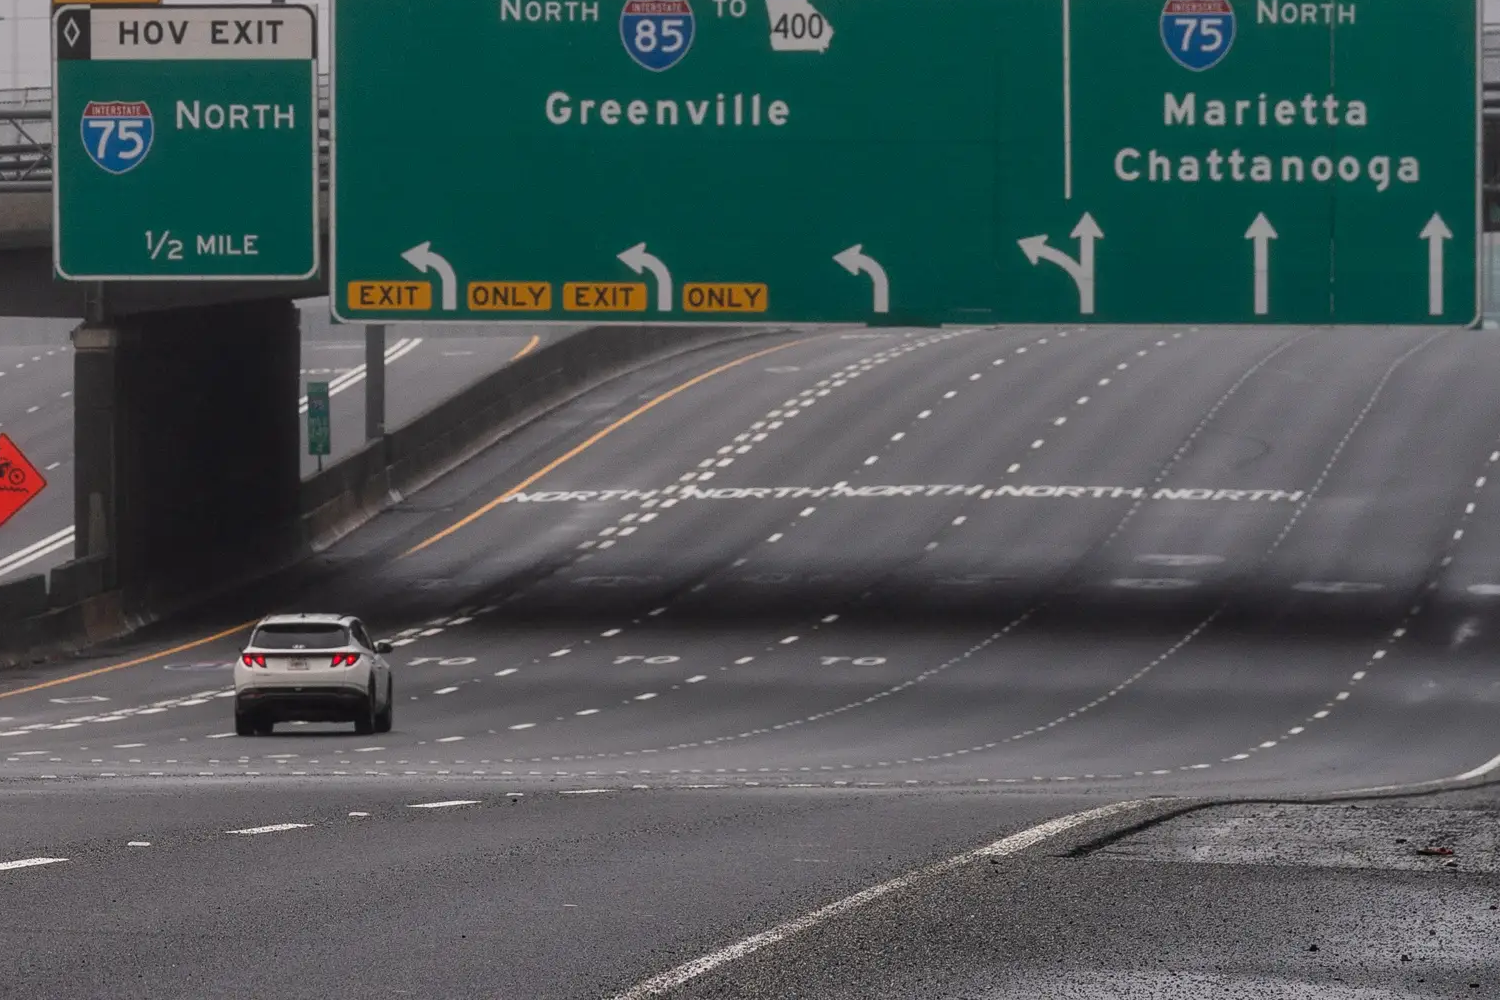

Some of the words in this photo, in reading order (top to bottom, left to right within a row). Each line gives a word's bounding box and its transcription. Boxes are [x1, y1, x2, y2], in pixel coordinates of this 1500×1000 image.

[631, 2, 682, 12] INTERSTATE
[1171, 2, 1222, 12] INTERSTATE
[118, 20, 190, 46] HOV
[210, 20, 286, 46] EXIT
[634, 18, 686, 54] 85
[772, 12, 824, 41] 400
[1172, 17, 1224, 53] 75
[91, 105, 142, 115] INTERSTATE
[544, 91, 792, 127] Greenville
[1163, 92, 1370, 127] Marietta
[88, 119, 145, 159] 75
[176, 101, 297, 131] NORTH
[1113, 147, 1422, 193] Chattanooga
[196, 235, 260, 257] MILE
[359, 286, 421, 307] EXIT
[472, 286, 547, 308] ONLY
[575, 287, 636, 308] EXIT
[688, 288, 763, 310] ONLY
[503, 490, 660, 502] NORTH
[681, 486, 831, 499] NORTH
[831, 484, 984, 497] NORTH
[993, 484, 1145, 499] NORTH
[1152, 487, 1304, 501] NORTH
[406, 656, 478, 666] TO
[612, 655, 682, 664] TO
[819, 656, 887, 666] TO
